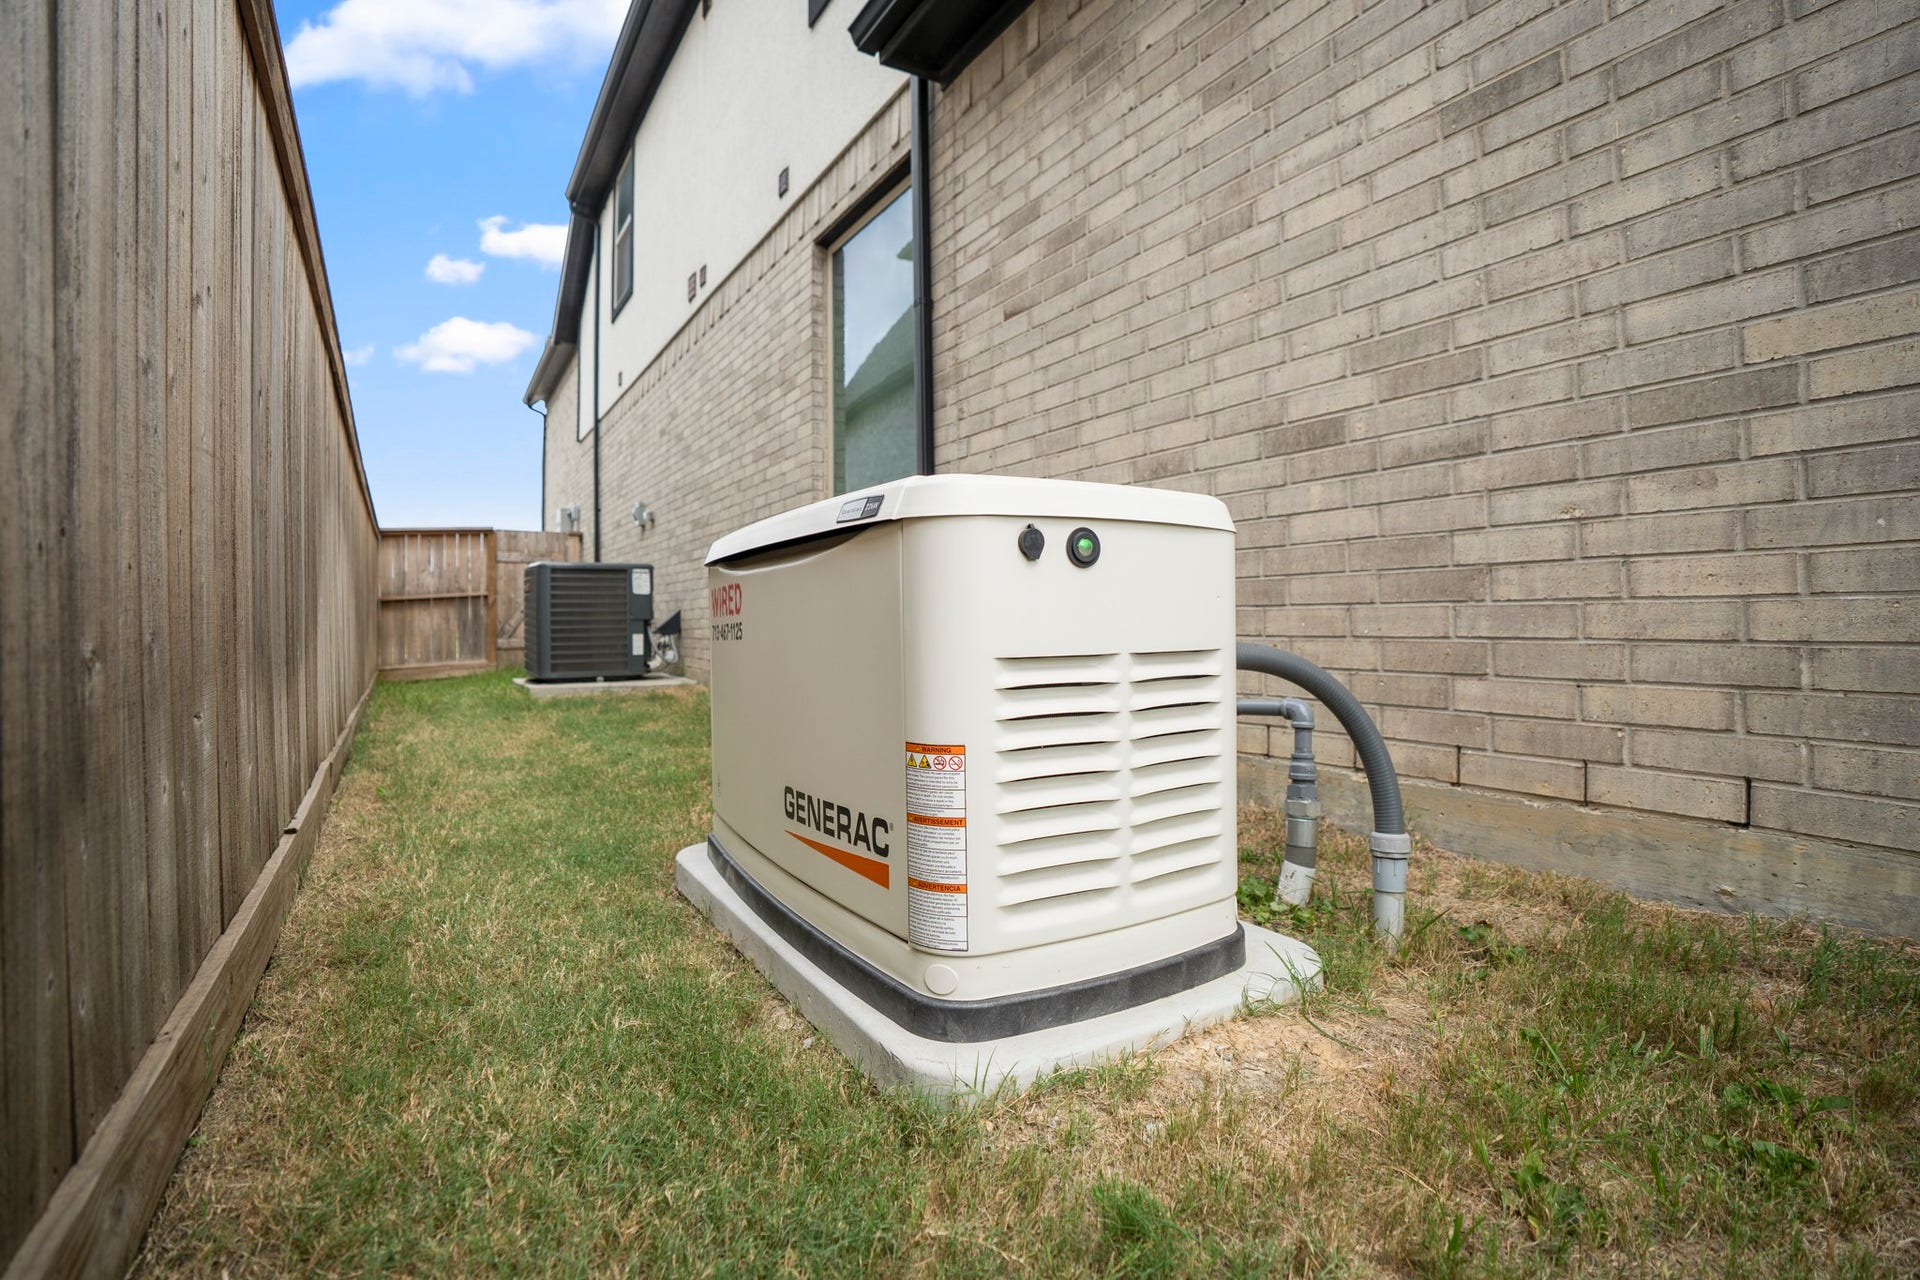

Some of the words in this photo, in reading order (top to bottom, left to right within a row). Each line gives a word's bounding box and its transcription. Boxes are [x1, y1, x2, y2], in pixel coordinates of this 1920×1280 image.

[711, 583, 742, 618] WIRED
[921, 746, 952, 754] WARNING
[784, 785, 889, 858] GENERAC
[913, 815, 963, 826] AVERTISSEMENT
[918, 881, 961, 892] ADVERTENCIA
